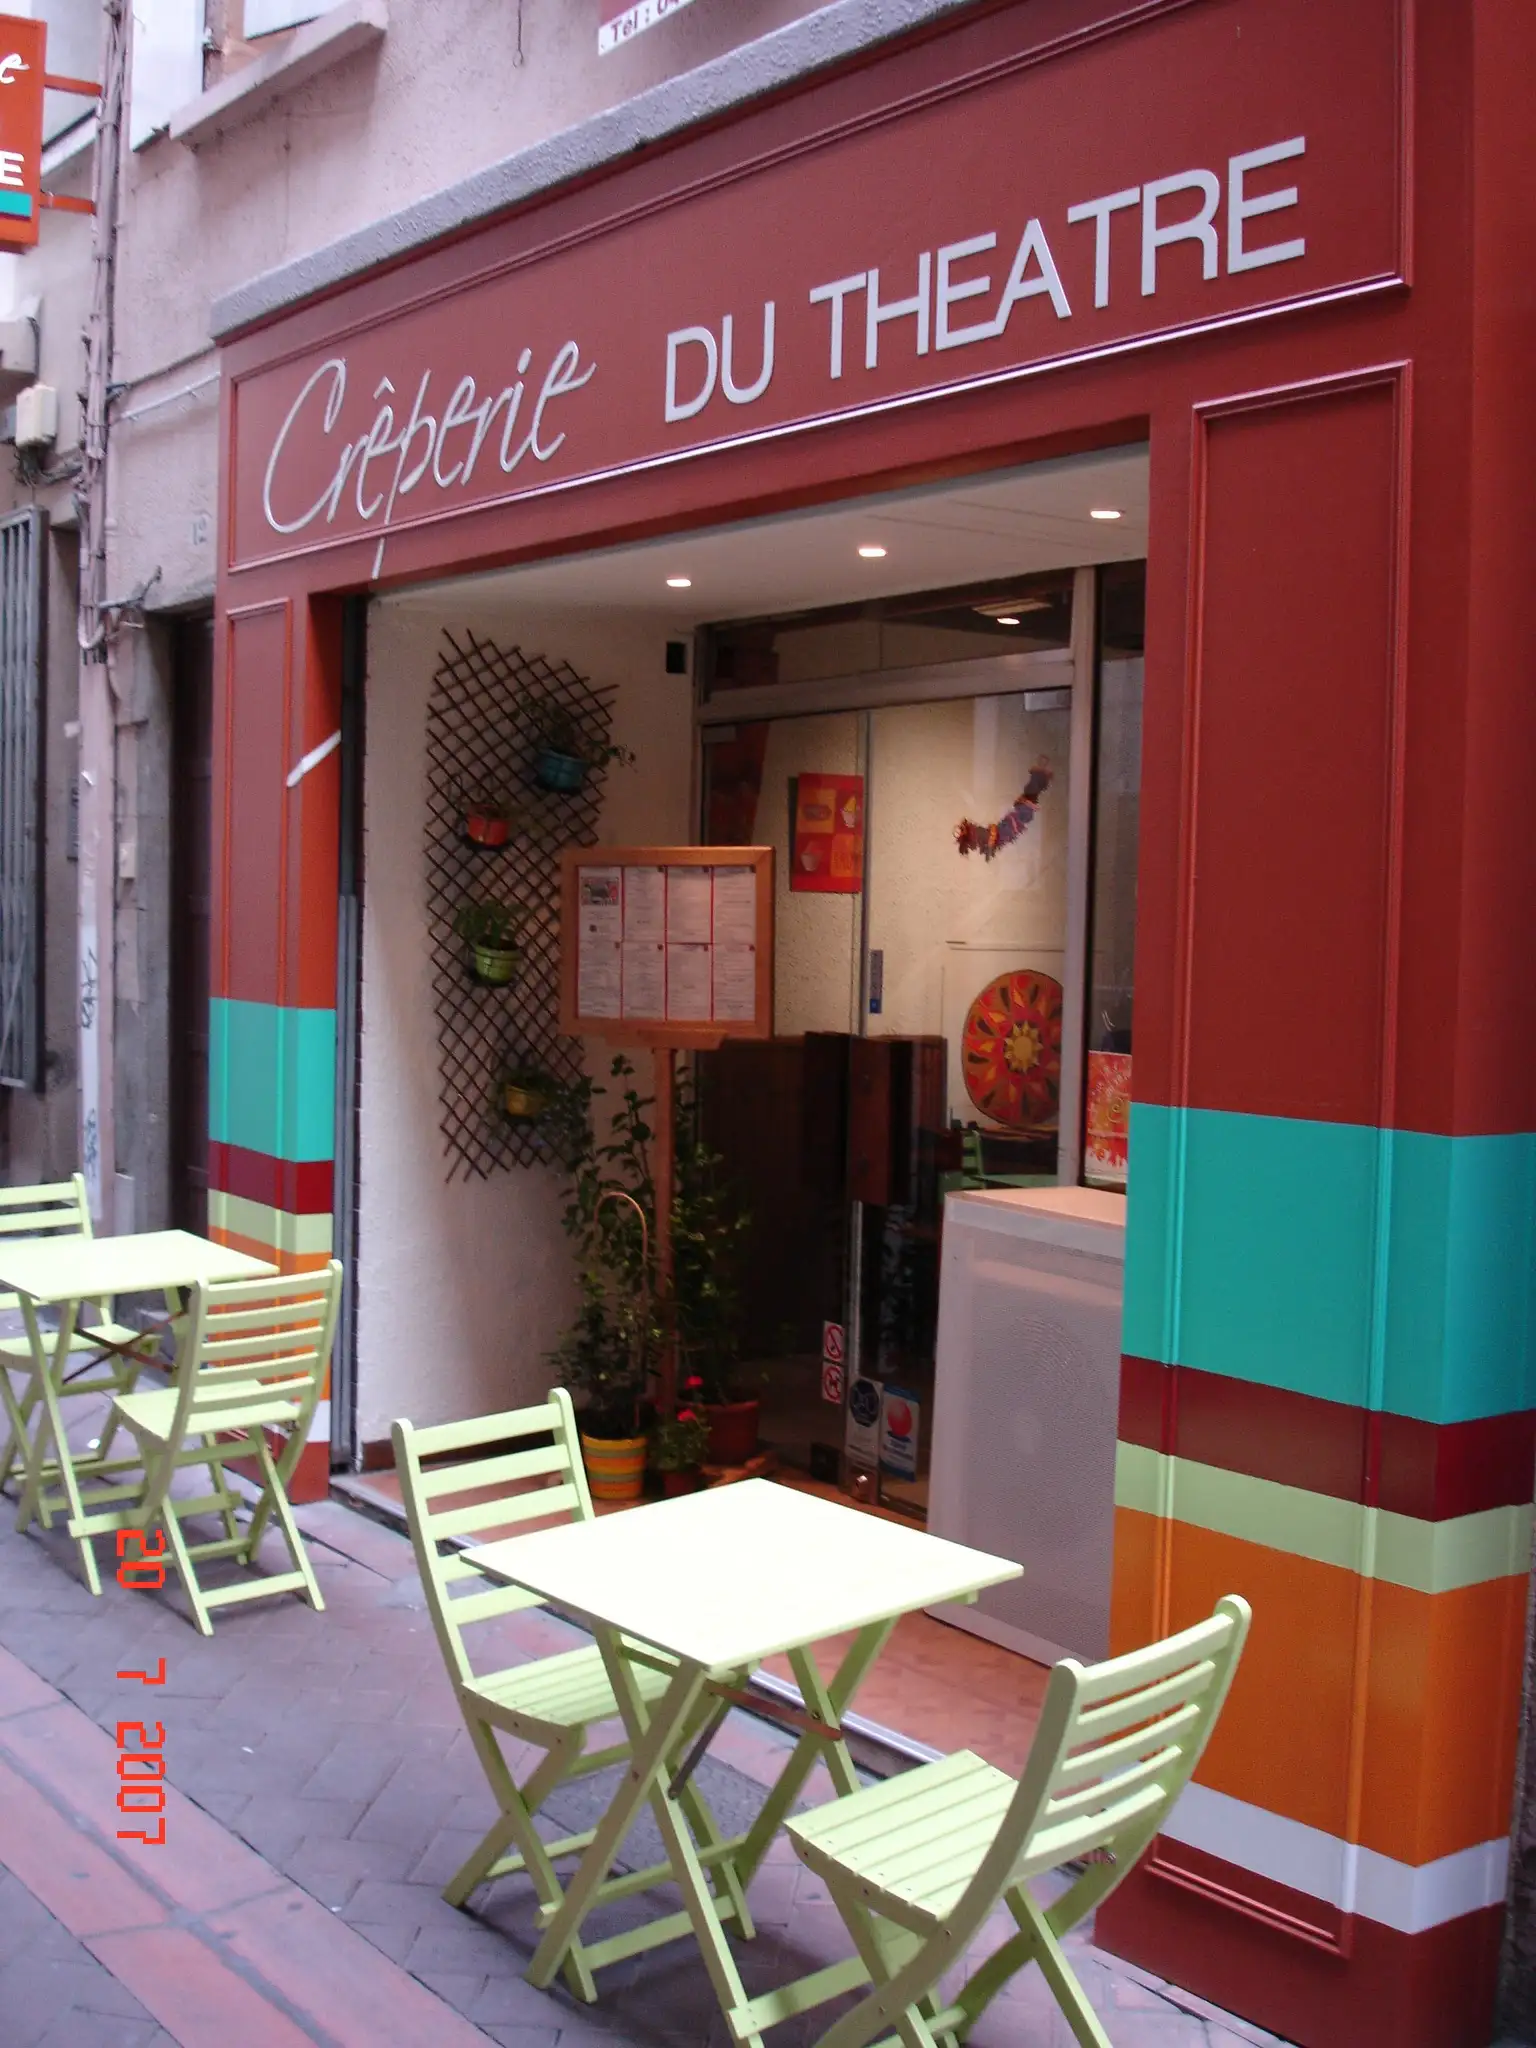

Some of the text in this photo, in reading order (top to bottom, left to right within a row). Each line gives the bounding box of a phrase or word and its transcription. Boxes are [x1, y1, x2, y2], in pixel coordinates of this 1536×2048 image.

[263, 136, 1305, 580] Crêperie DU THEATRE
